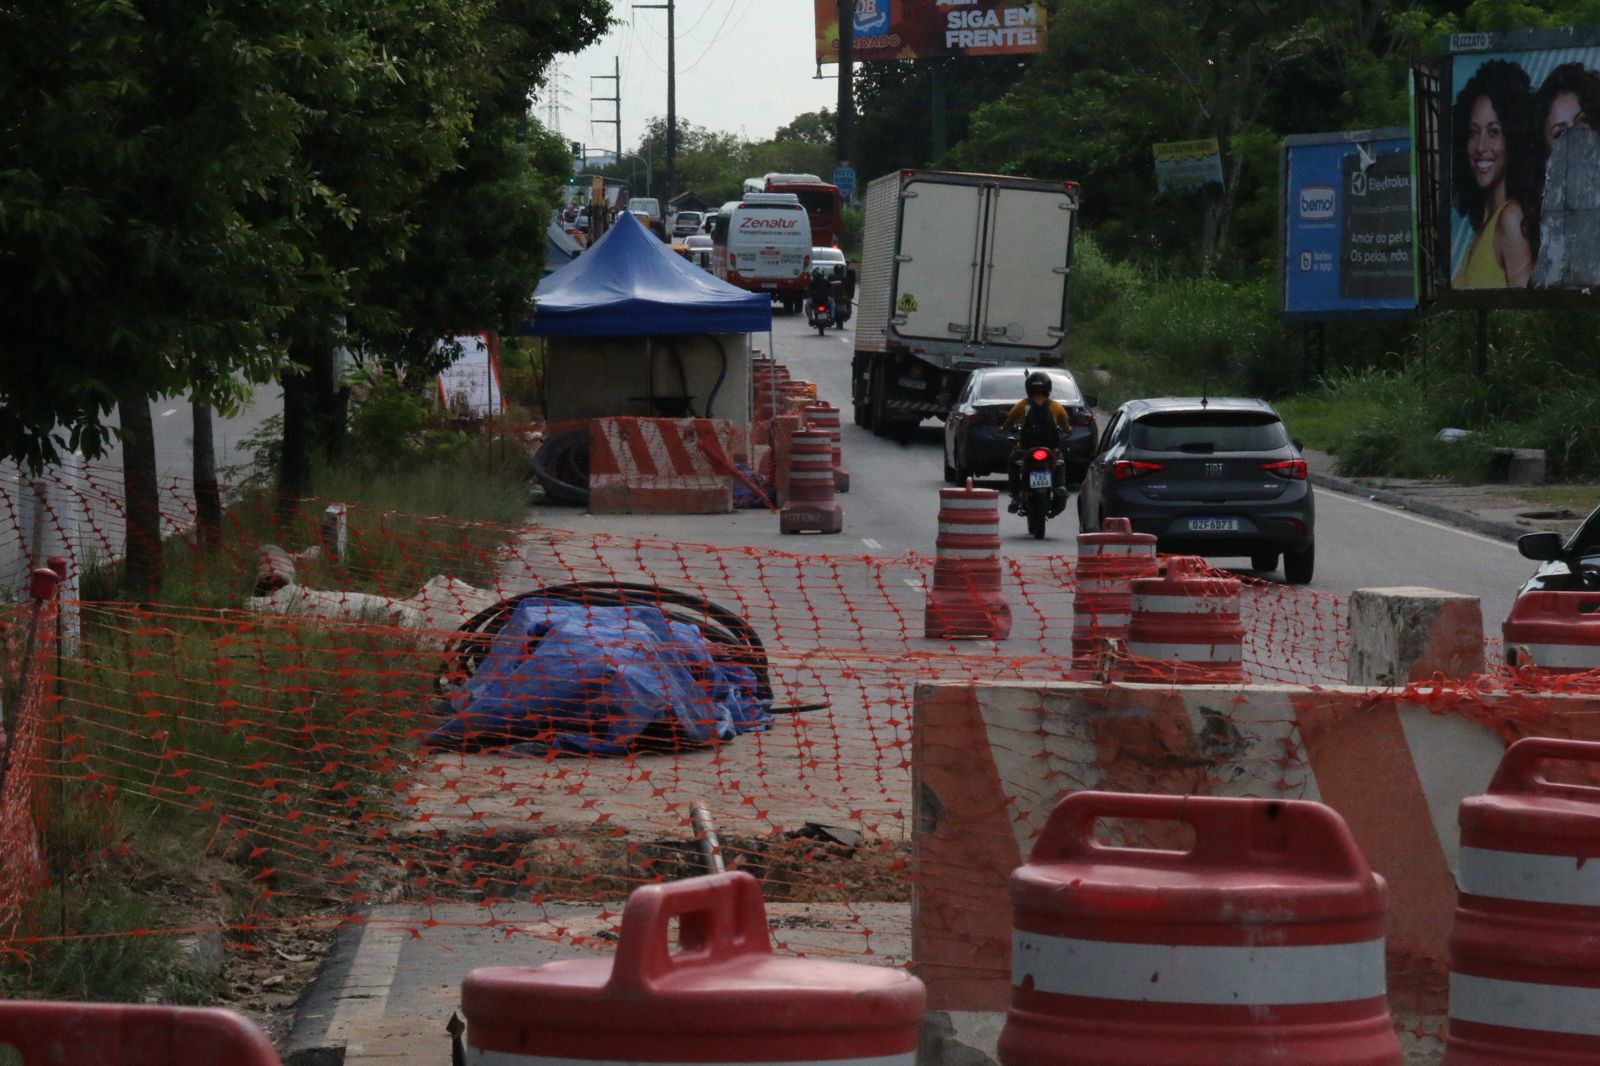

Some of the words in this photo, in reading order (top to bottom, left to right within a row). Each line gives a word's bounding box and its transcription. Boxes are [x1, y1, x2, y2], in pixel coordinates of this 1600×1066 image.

[947, 9, 1000, 29] SIGA
[1004, 7, 1037, 26] EM
[946, 28, 1037, 48] FRENTE!
[1368, 174, 1410, 191] Electrolux
[1301, 195, 1334, 212] bemol
[740, 216, 798, 229] Zenatur
[1351, 232, 1373, 244] Amor
[1376, 233, 1386, 243] do
[1388, 231, 1403, 246] pet
[1350, 249, 1362, 262] Os
[1319, 263, 1333, 273] app
